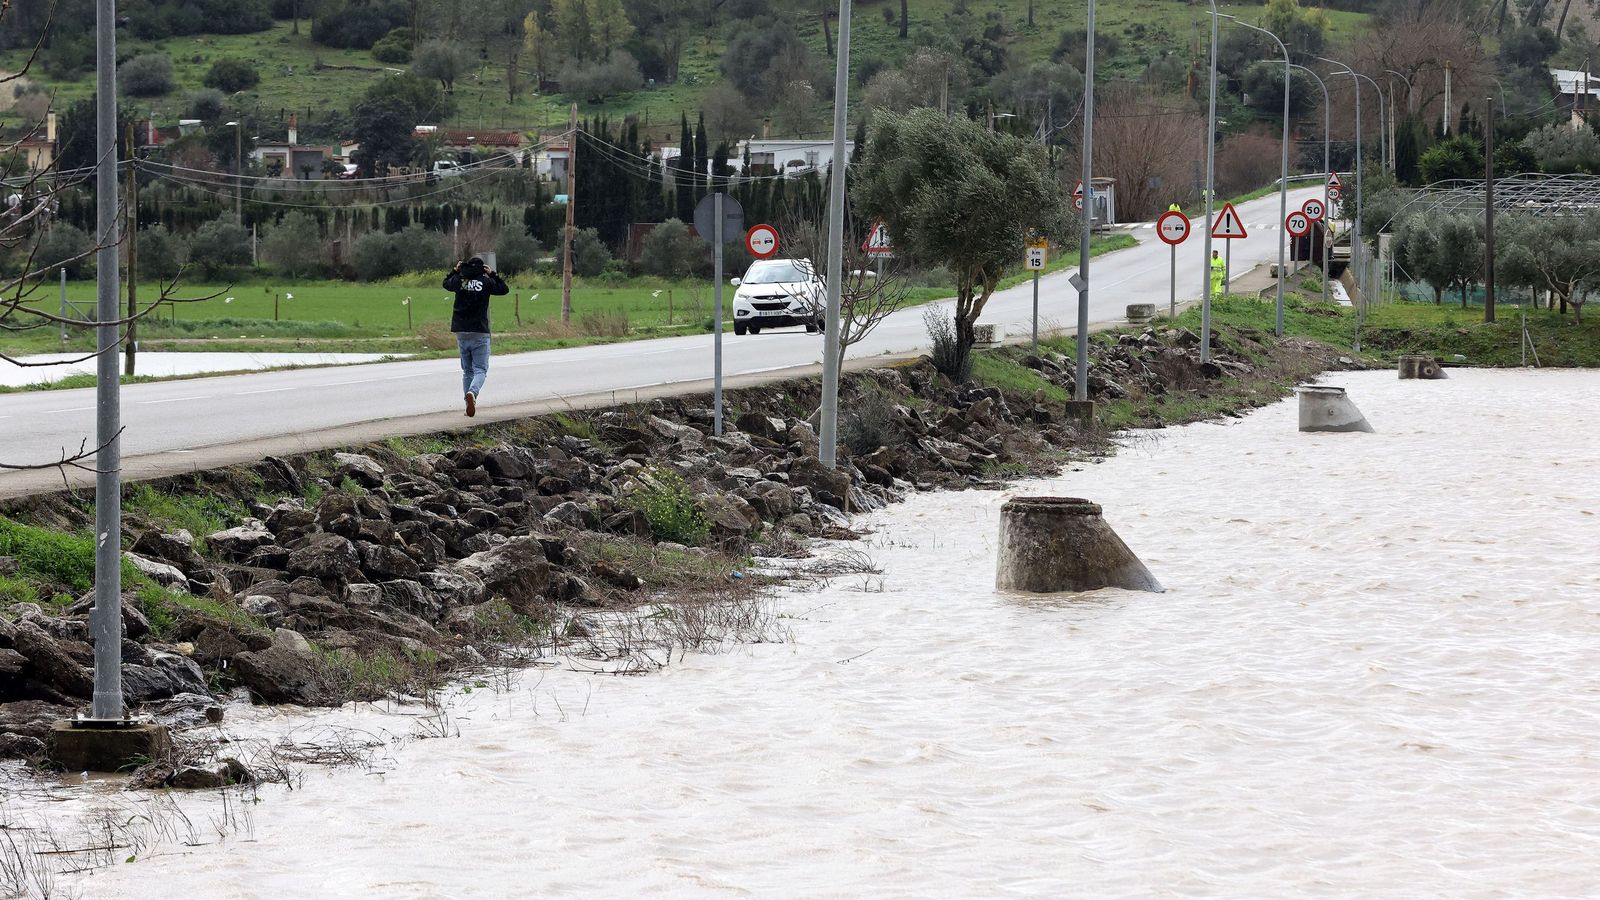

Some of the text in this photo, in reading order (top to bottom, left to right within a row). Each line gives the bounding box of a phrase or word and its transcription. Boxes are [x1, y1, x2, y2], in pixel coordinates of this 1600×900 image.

[1306, 206, 1320, 215] 50
[1291, 219, 1305, 229] 70
[1030, 258, 1041, 267] 15
